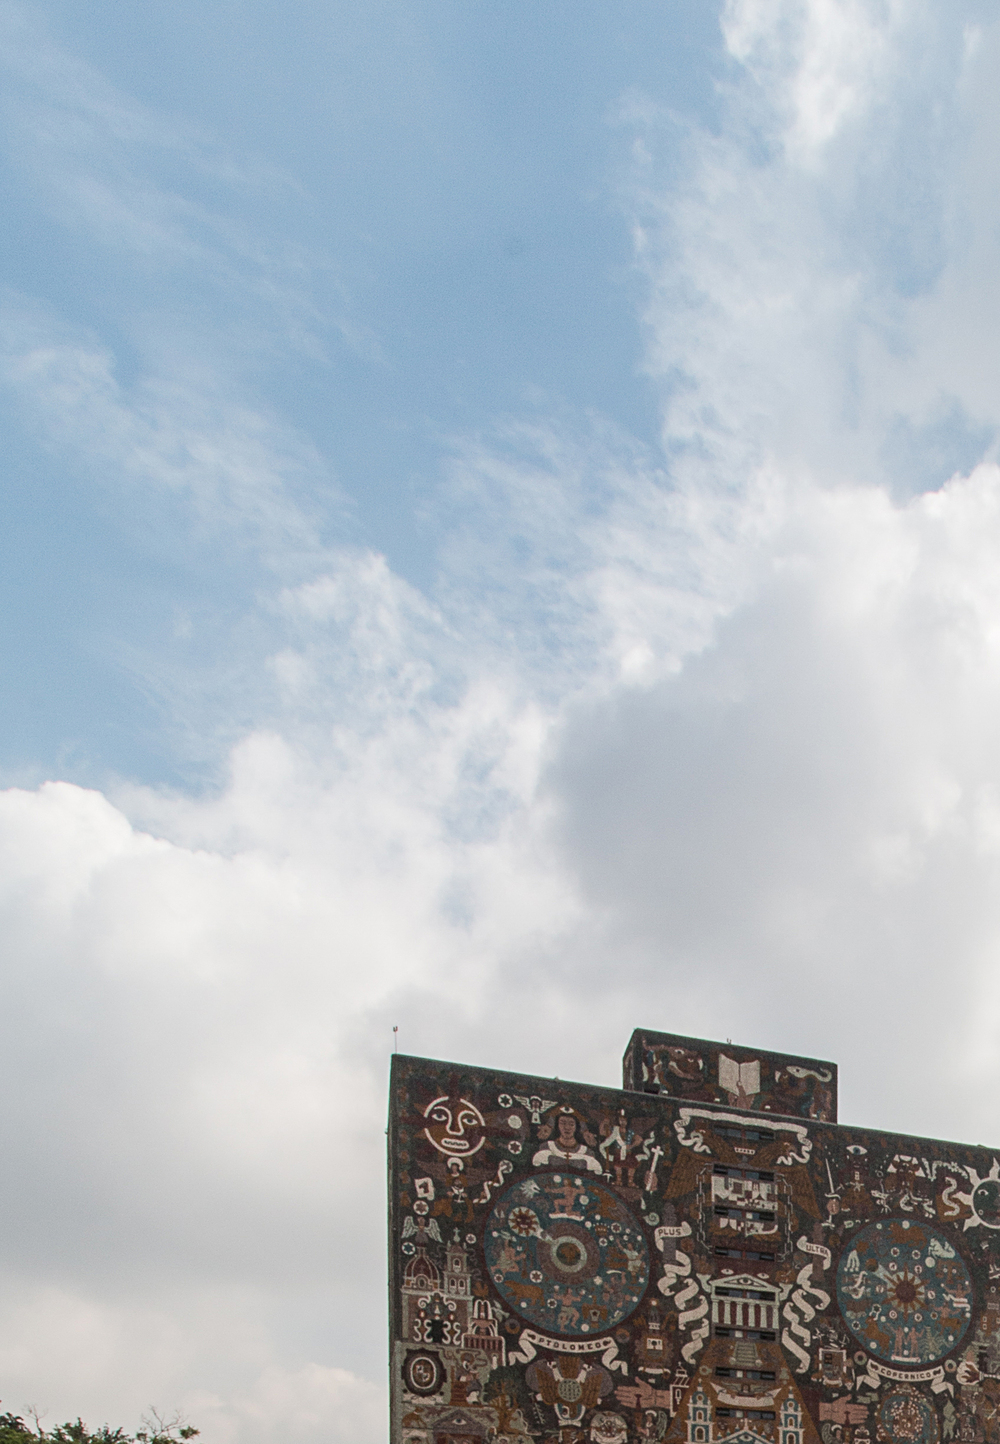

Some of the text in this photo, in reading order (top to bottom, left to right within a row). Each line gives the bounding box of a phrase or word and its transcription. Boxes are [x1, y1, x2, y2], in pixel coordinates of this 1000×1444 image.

[658, 1228, 682, 1237] PLUS
[805, 1244, 829, 1257] ULTRA
[539, 1337, 601, 1351] PTOLOMEO
[880, 1367, 932, 1380] COPERNICO
